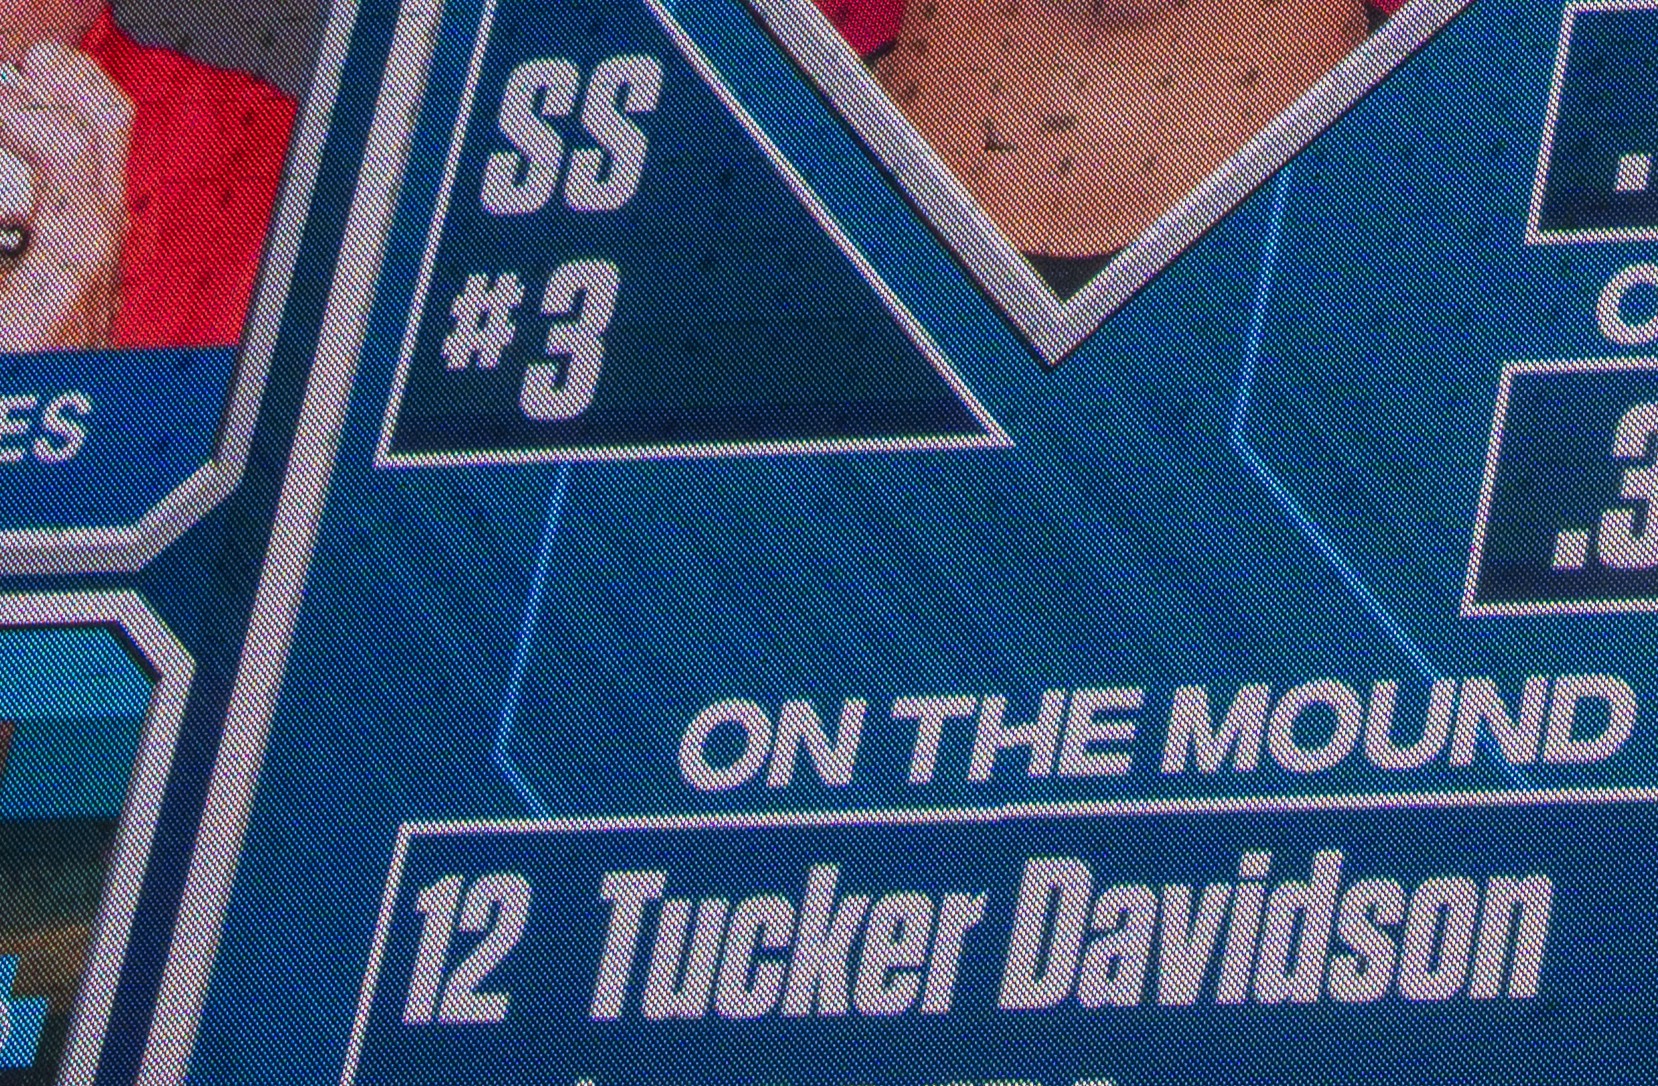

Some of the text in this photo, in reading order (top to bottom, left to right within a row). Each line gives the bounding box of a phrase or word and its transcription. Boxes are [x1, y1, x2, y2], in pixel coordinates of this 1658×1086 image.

[481, 54, 661, 216] SS
[442, 259, 621, 422] #3
[677, 673, 1638, 792] ON THE MOUND
[403, 848, 1554, 1025] 12 Tucker Davidson
